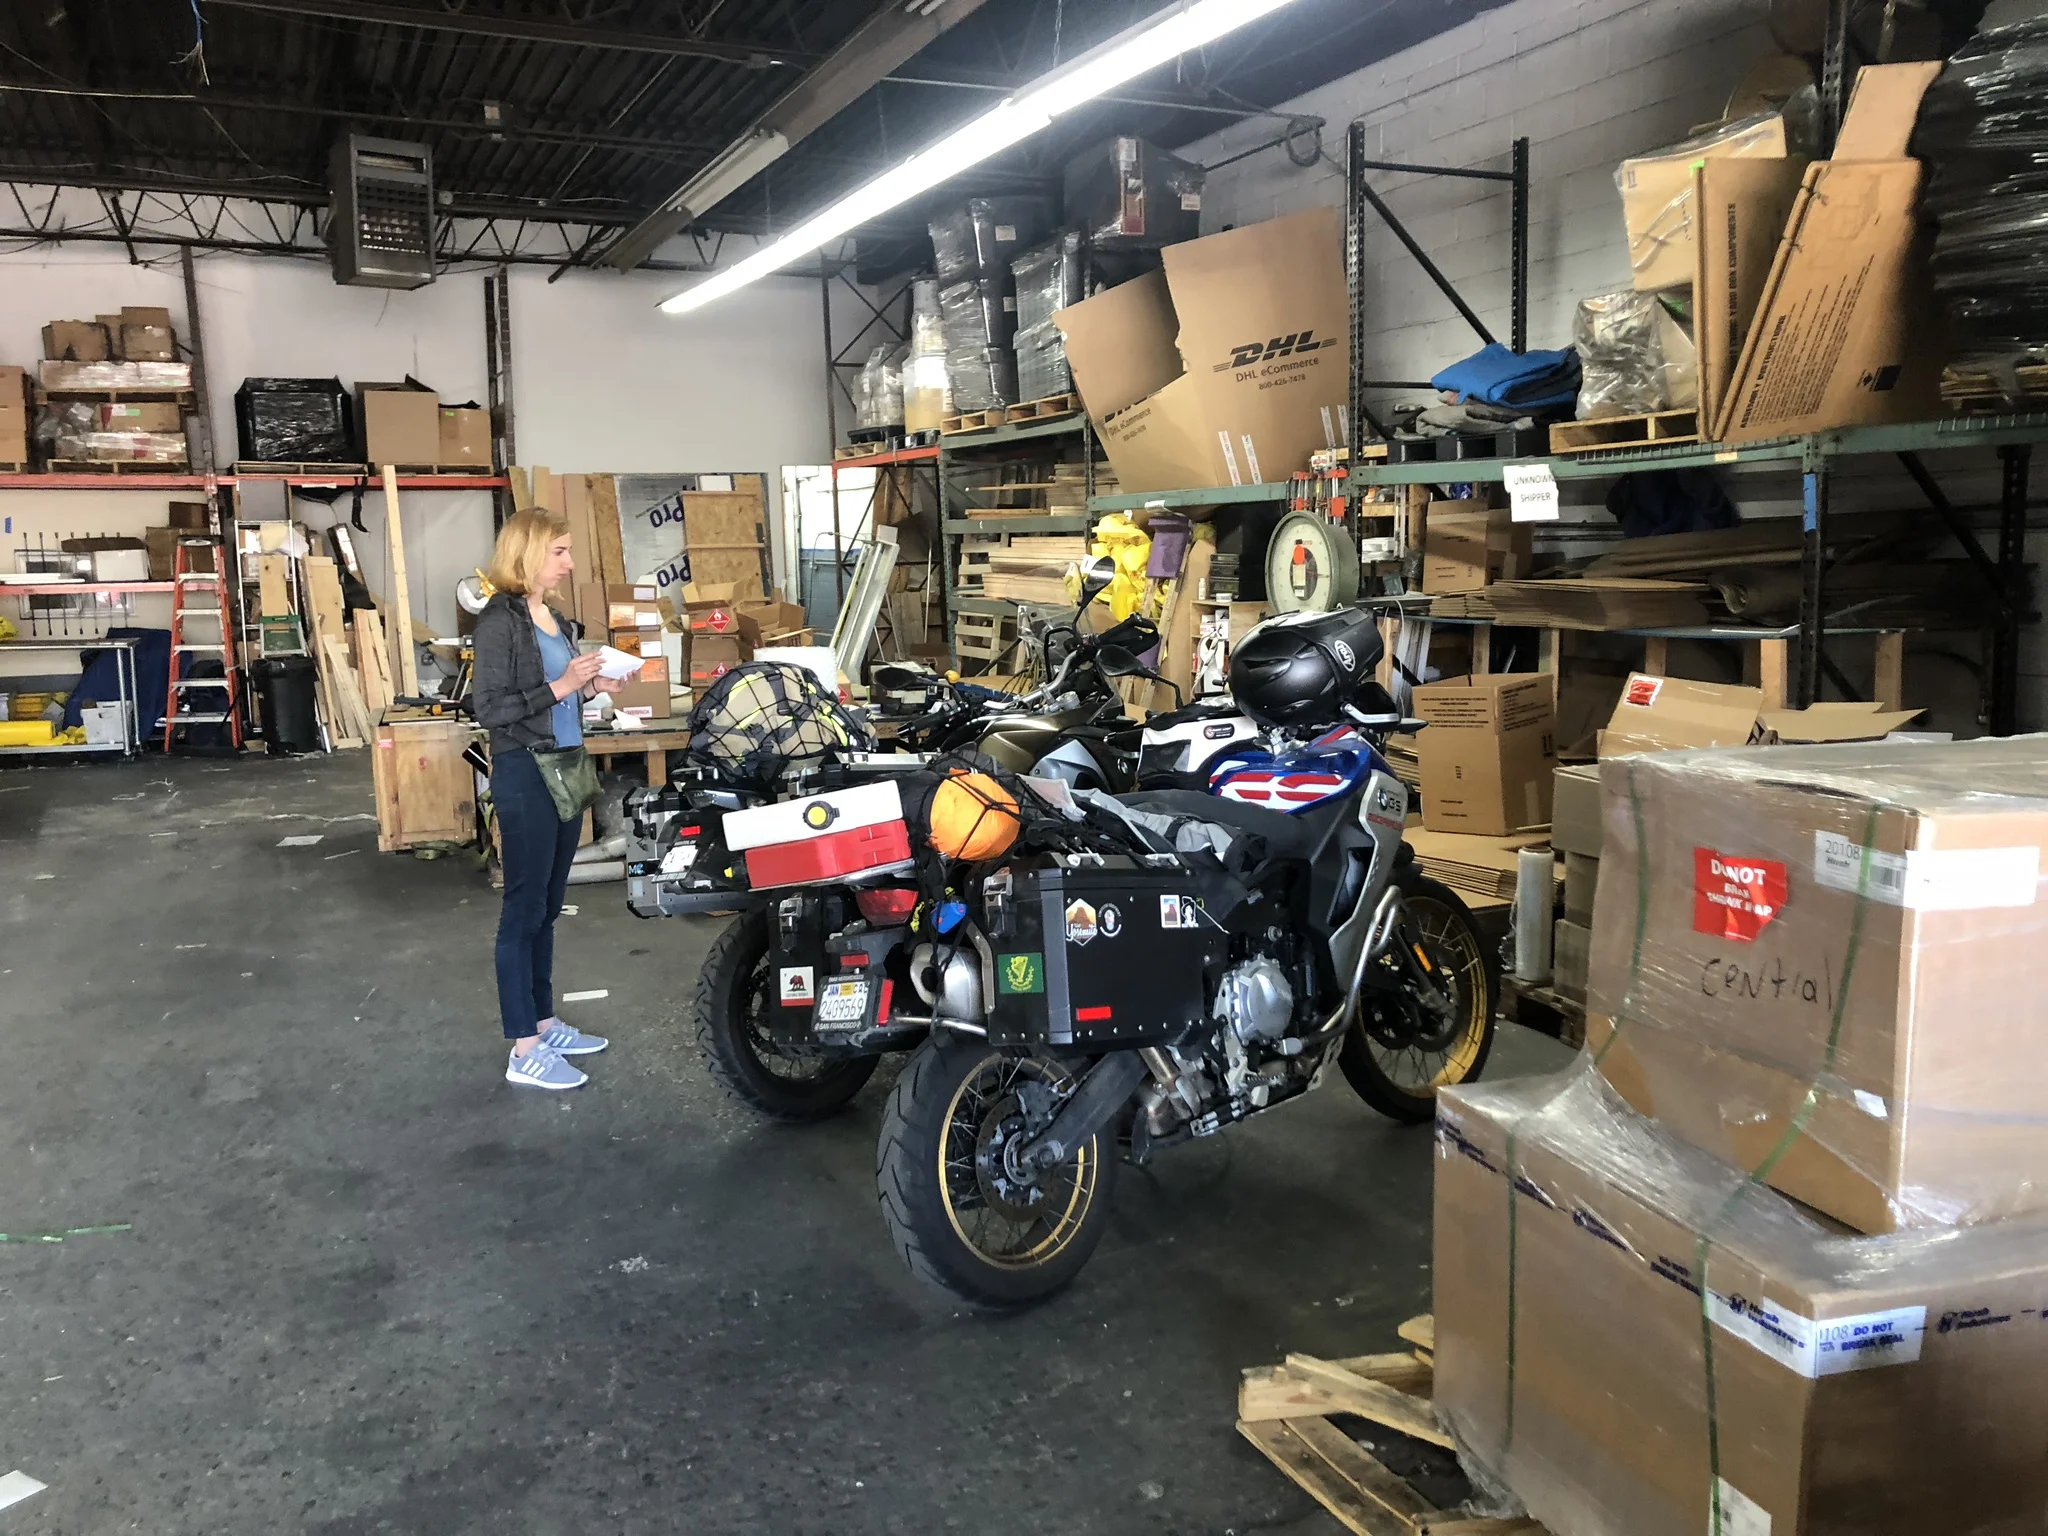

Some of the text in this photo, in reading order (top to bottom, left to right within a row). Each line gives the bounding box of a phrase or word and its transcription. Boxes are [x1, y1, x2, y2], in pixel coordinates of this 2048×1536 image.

[1230, 329, 1321, 369] DHL
[1236, 356, 1320, 383] DHL eCommerce
[1513, 474, 1556, 485] UNKNOWN
[1520, 491, 1552, 503] SHIPPER
[649, 495, 685, 528] Pro
[656, 554, 692, 588] Pro
[1336, 642, 1354, 667] Arai
[1825, 839, 1860, 861] 20108
[1725, 866, 1767, 886] NOT
[829, 1021, 856, 1029] FRANCISCO
[1852, 1321, 1895, 1337] DO NOT
